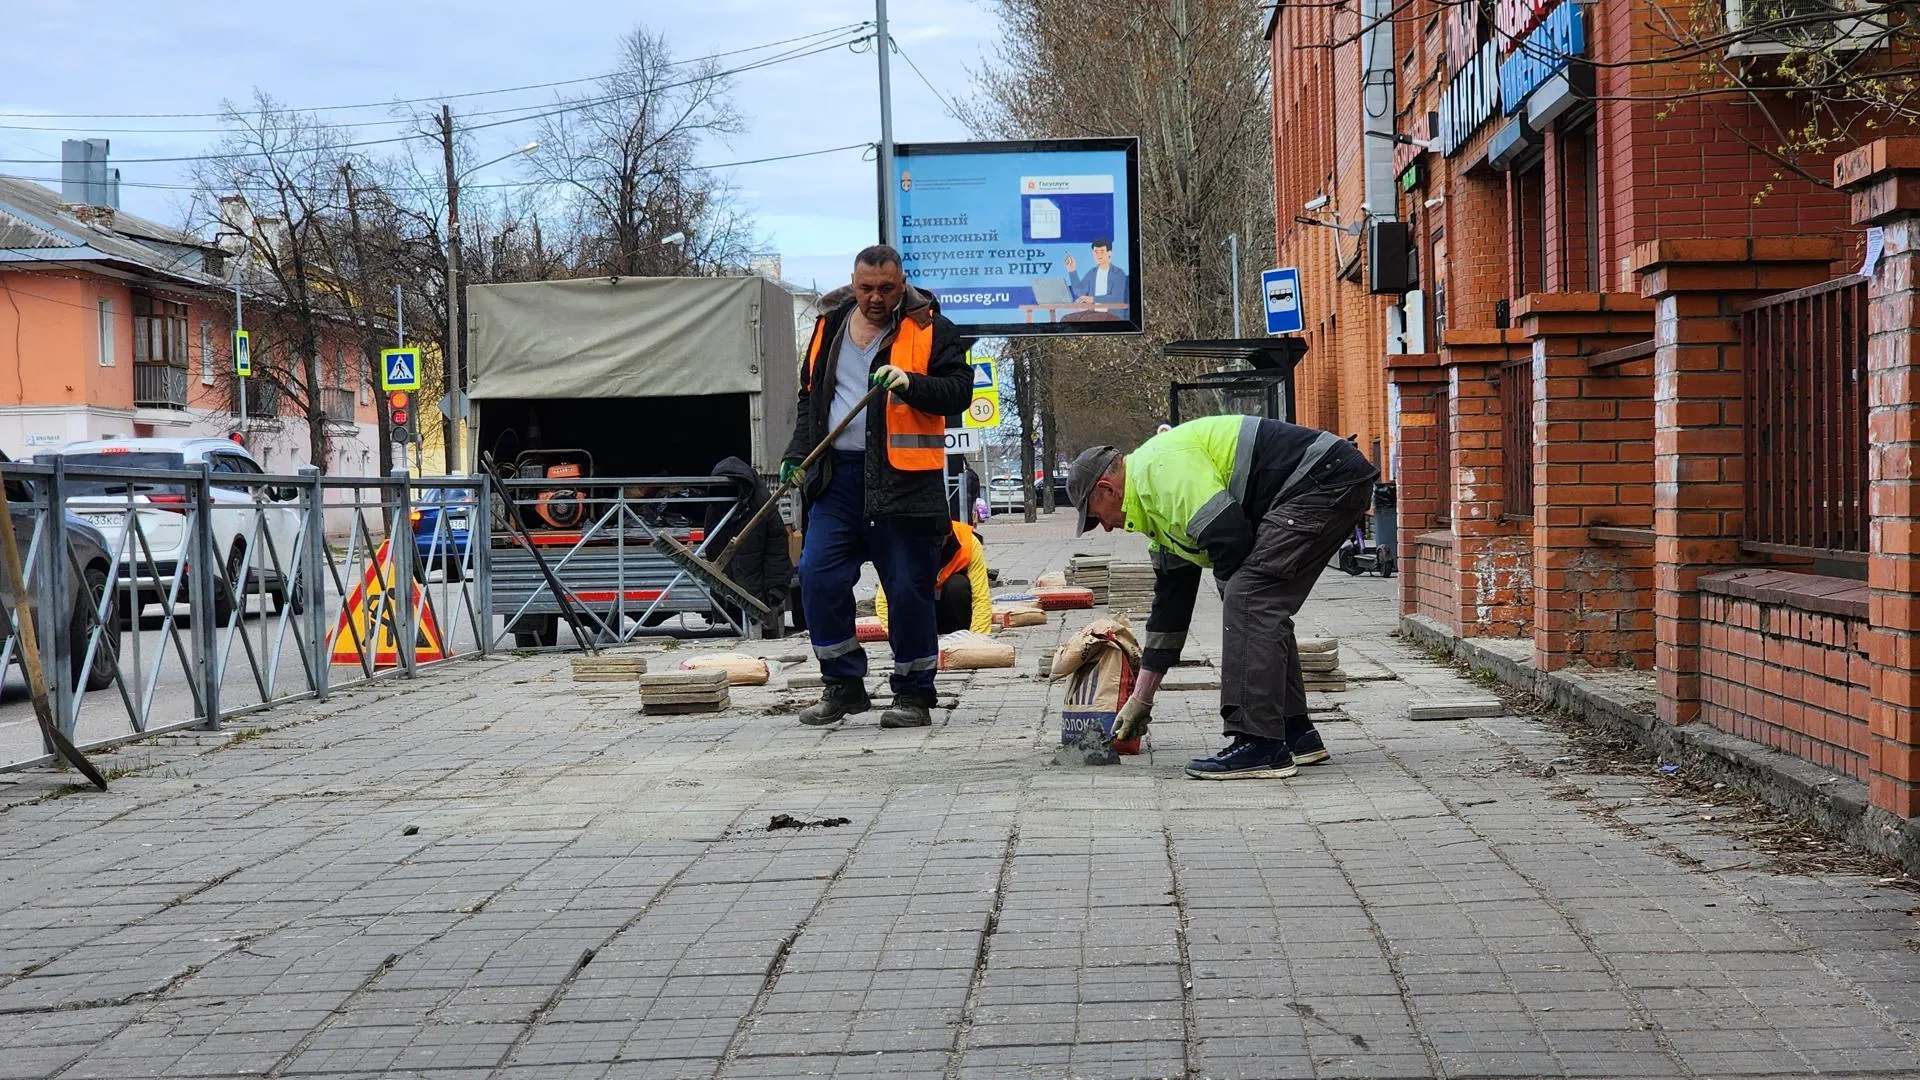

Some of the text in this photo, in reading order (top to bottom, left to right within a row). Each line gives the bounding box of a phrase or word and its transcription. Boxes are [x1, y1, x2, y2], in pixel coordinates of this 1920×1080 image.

[902, 213, 968, 227] Единый
[902, 229, 998, 244] платежный
[902, 248, 1045, 263] документ теперь
[904, 262, 1053, 279] доступен на РПГУ
[974, 404, 990, 415] 30
[944, 433, 970, 449] ОП
